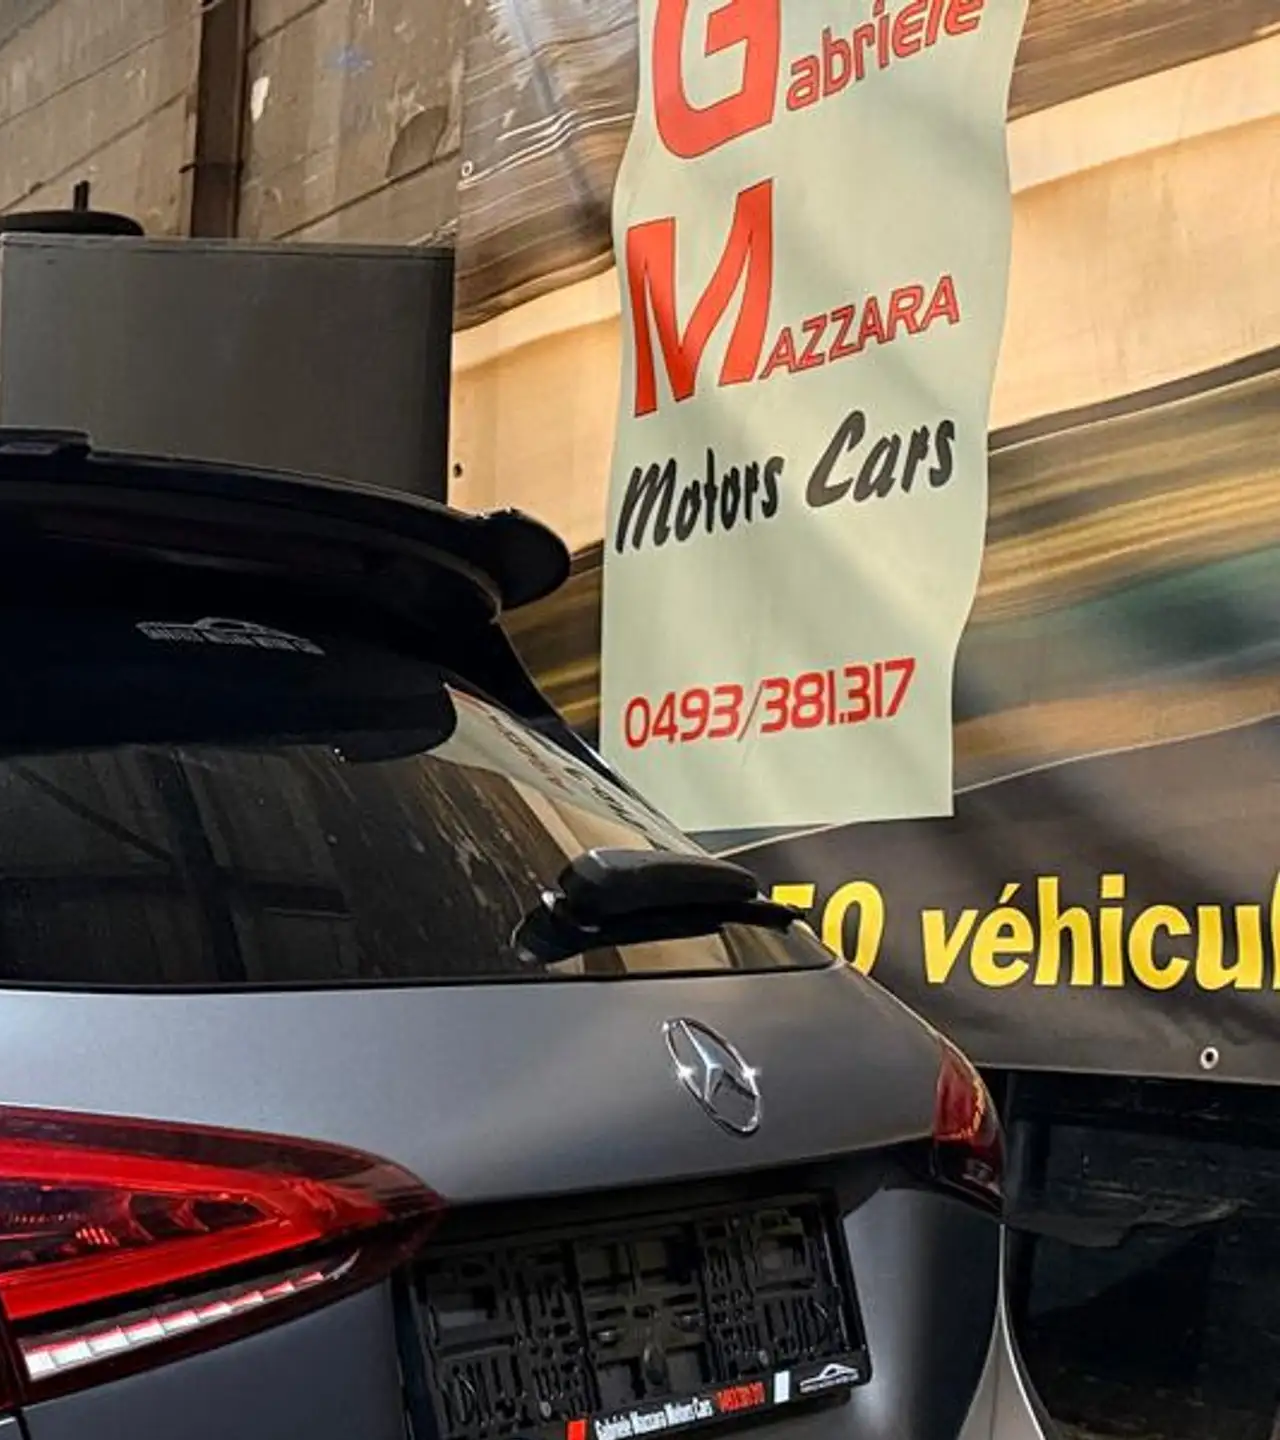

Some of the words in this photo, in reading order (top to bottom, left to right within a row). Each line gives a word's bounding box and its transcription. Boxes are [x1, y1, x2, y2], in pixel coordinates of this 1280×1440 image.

[652, 0, 983, 160] Gabriele
[615, 447, 785, 553] Motors
[806, 409, 956, 508] Cars
